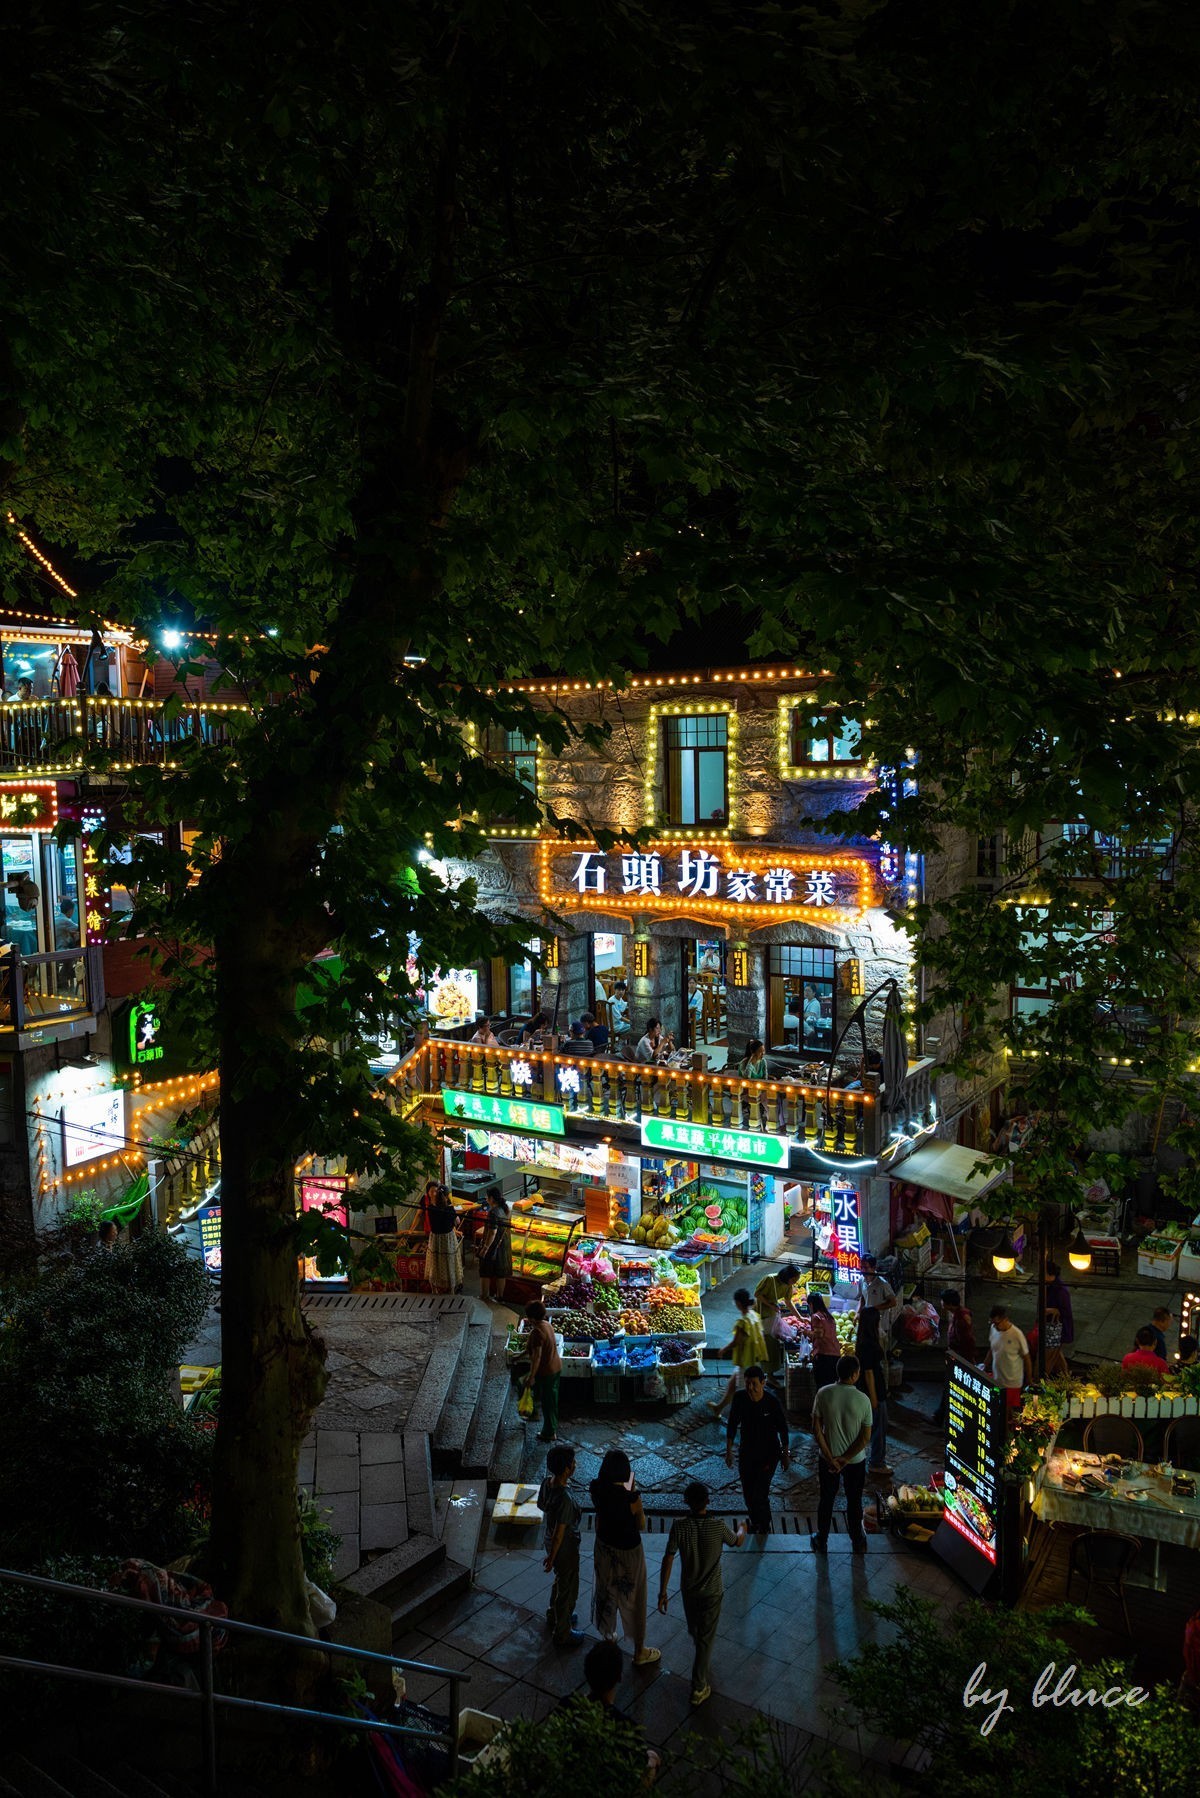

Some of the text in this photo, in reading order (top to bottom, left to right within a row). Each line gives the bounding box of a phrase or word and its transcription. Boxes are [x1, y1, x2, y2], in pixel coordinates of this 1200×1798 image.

[572, 849, 837, 906] 石頭坊家常菜
[834, 1194, 859, 1252] 水果
[837, 1252, 860, 1268] 特价
[837, 1267, 861, 1283] 超市
[953, 1365, 991, 1403] 特价菜品
